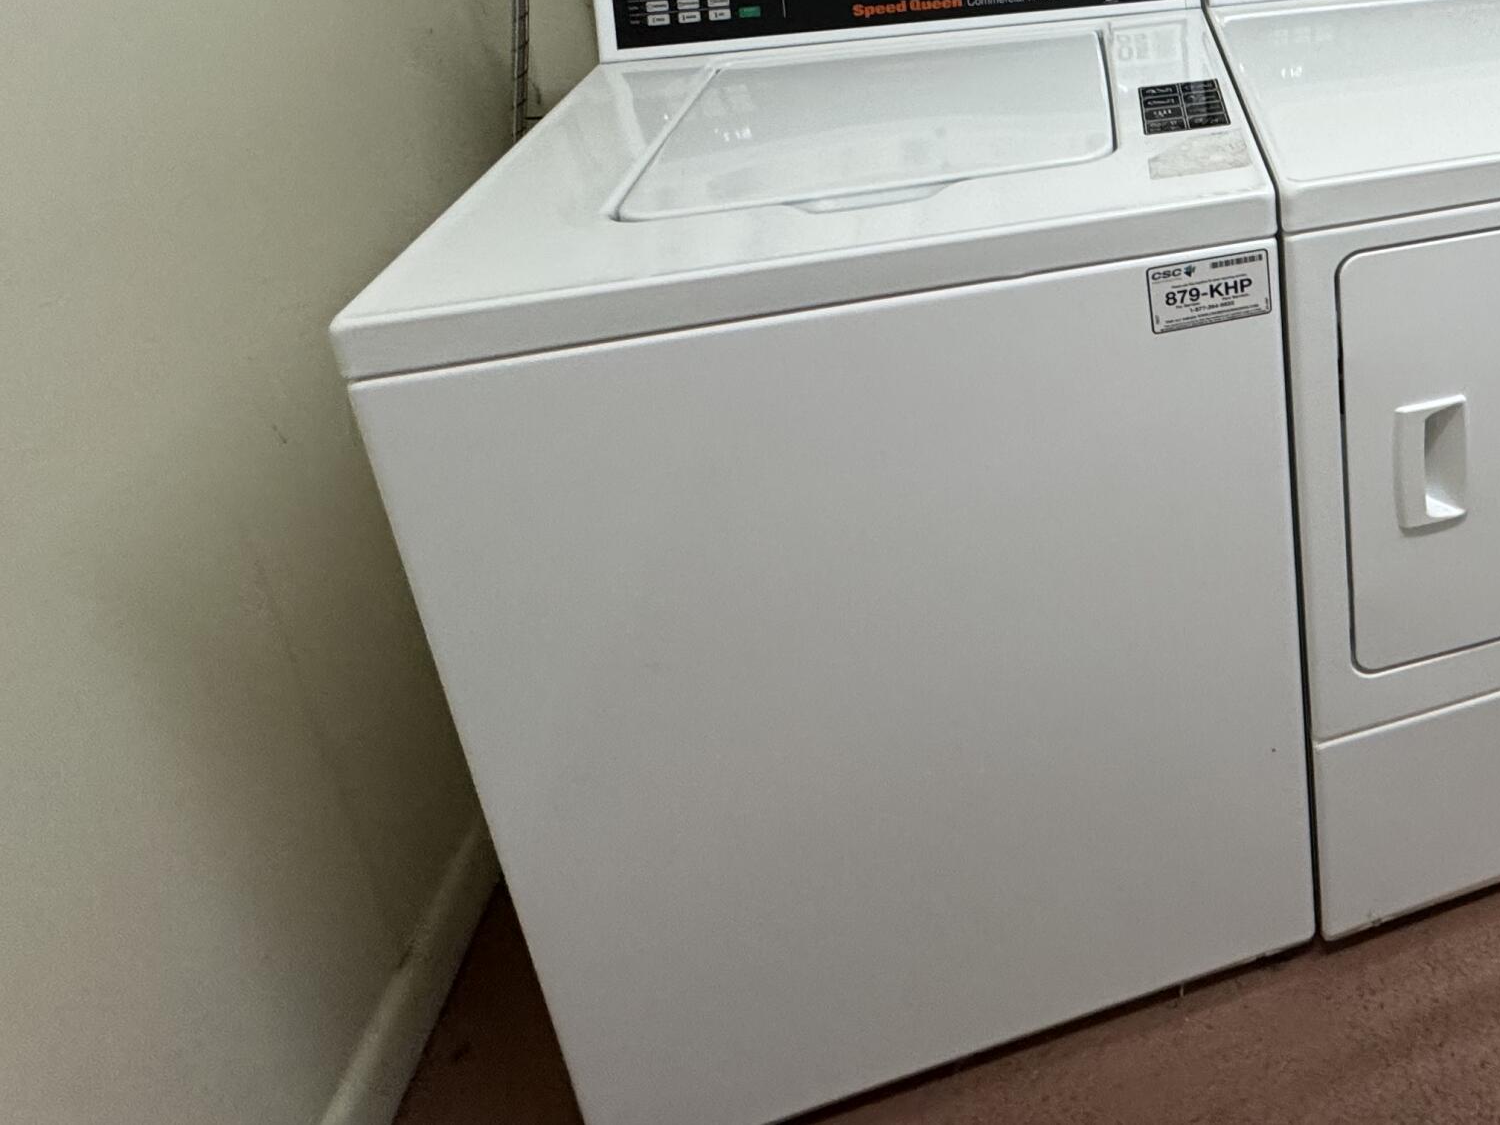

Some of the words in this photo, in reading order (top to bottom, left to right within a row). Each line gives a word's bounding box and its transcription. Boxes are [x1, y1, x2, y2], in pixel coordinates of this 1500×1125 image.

[852, 0, 906, 18] Speed
[1151, 268, 1182, 281] CSC
[1165, 278, 1252, 306] 879-KHP
